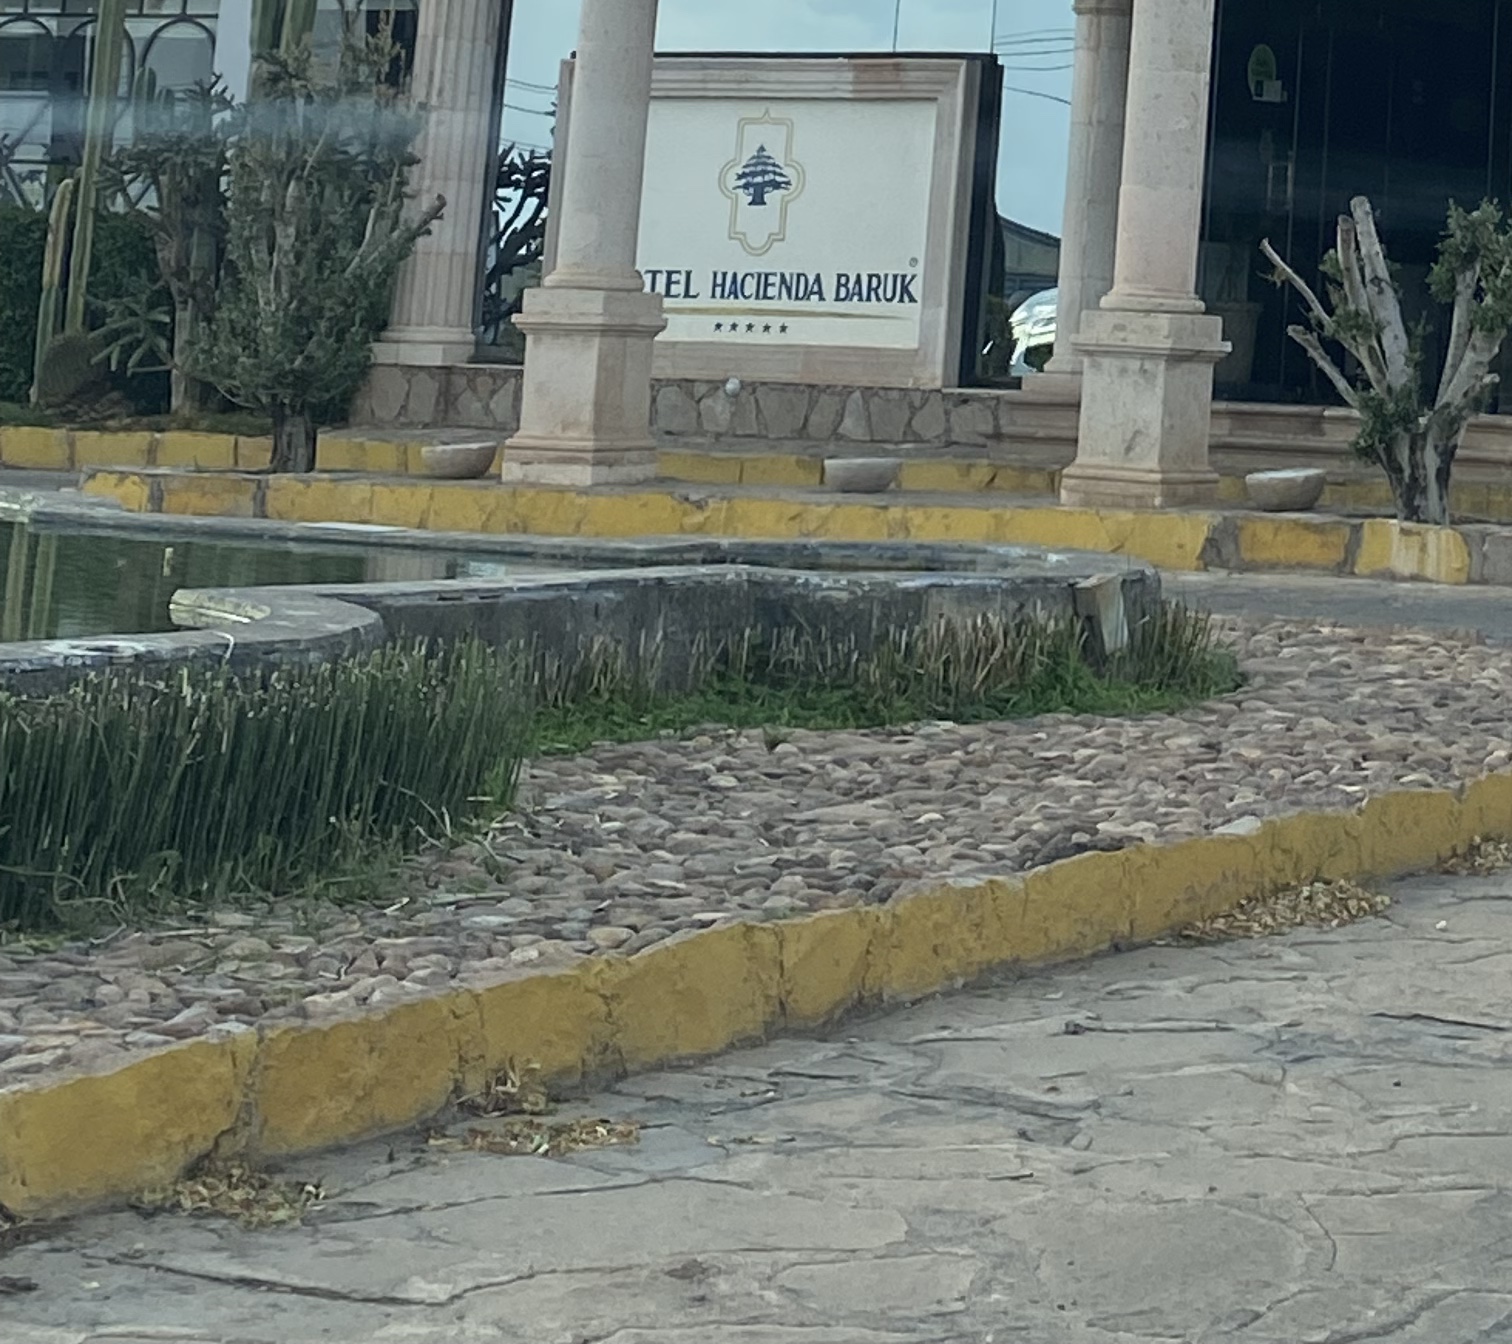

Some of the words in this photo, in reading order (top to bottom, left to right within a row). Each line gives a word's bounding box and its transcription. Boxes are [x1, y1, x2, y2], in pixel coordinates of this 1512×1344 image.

[643, 269, 700, 299] TEL
[710, 270, 826, 302] HACIENDA
[834, 273, 918, 304] BARUK
